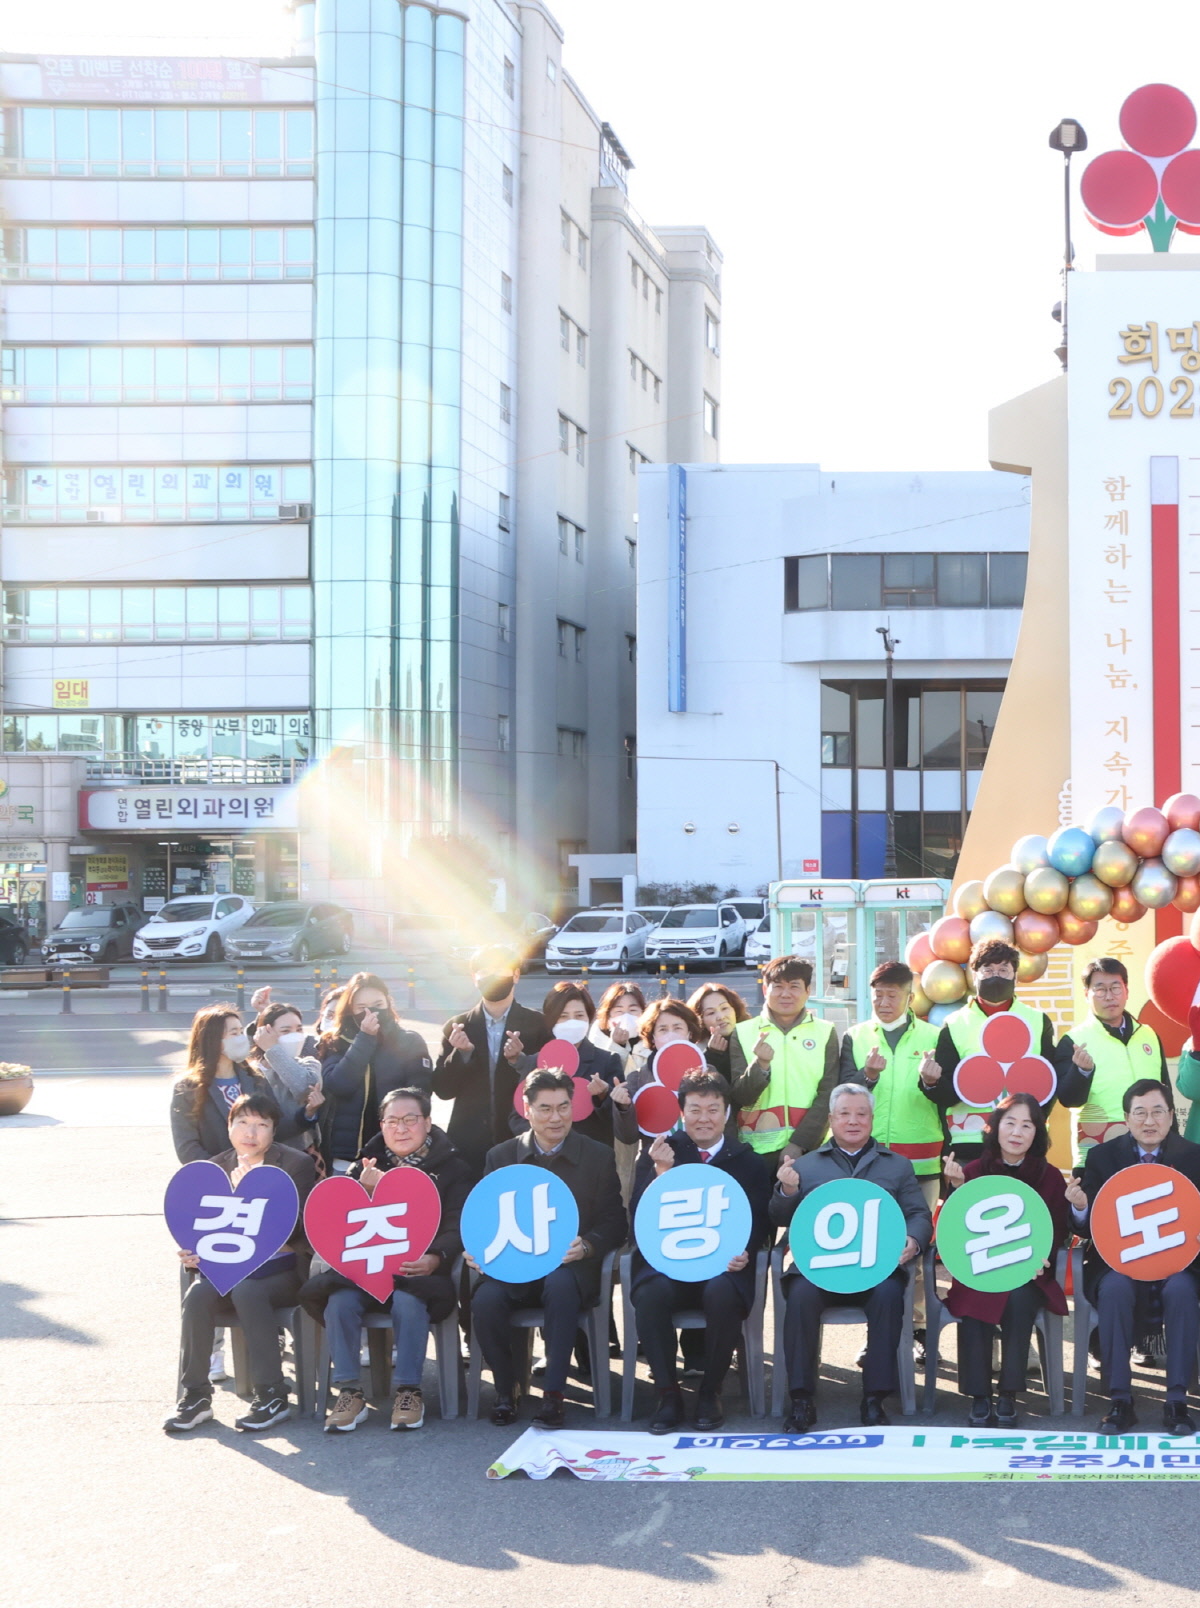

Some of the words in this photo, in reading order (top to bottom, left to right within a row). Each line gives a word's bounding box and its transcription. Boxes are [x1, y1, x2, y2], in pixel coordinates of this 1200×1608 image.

[44, 58, 74, 77] 오픈
[80, 60, 123, 78] 이벤트
[129, 61, 173, 79] 선착순
[227, 61, 256, 79] 헬스
[1102, 476, 1132, 605] 함께하는
[56, 681, 89, 699] 임대
[178, 718, 203, 737] 중앙
[134, 797, 275, 821] 열린외과의원
[810, 889, 824, 901] kt
[897, 887, 911, 899] kt
[193, 1194, 269, 1264] 경
[340, 1202, 412, 1275] 주
[484, 1183, 557, 1264] 사
[658, 1184, 730, 1260] 랑
[809, 1198, 883, 1270] 의
[963, 1193, 1033, 1276] 온
[1115, 1180, 1187, 1264] 도
